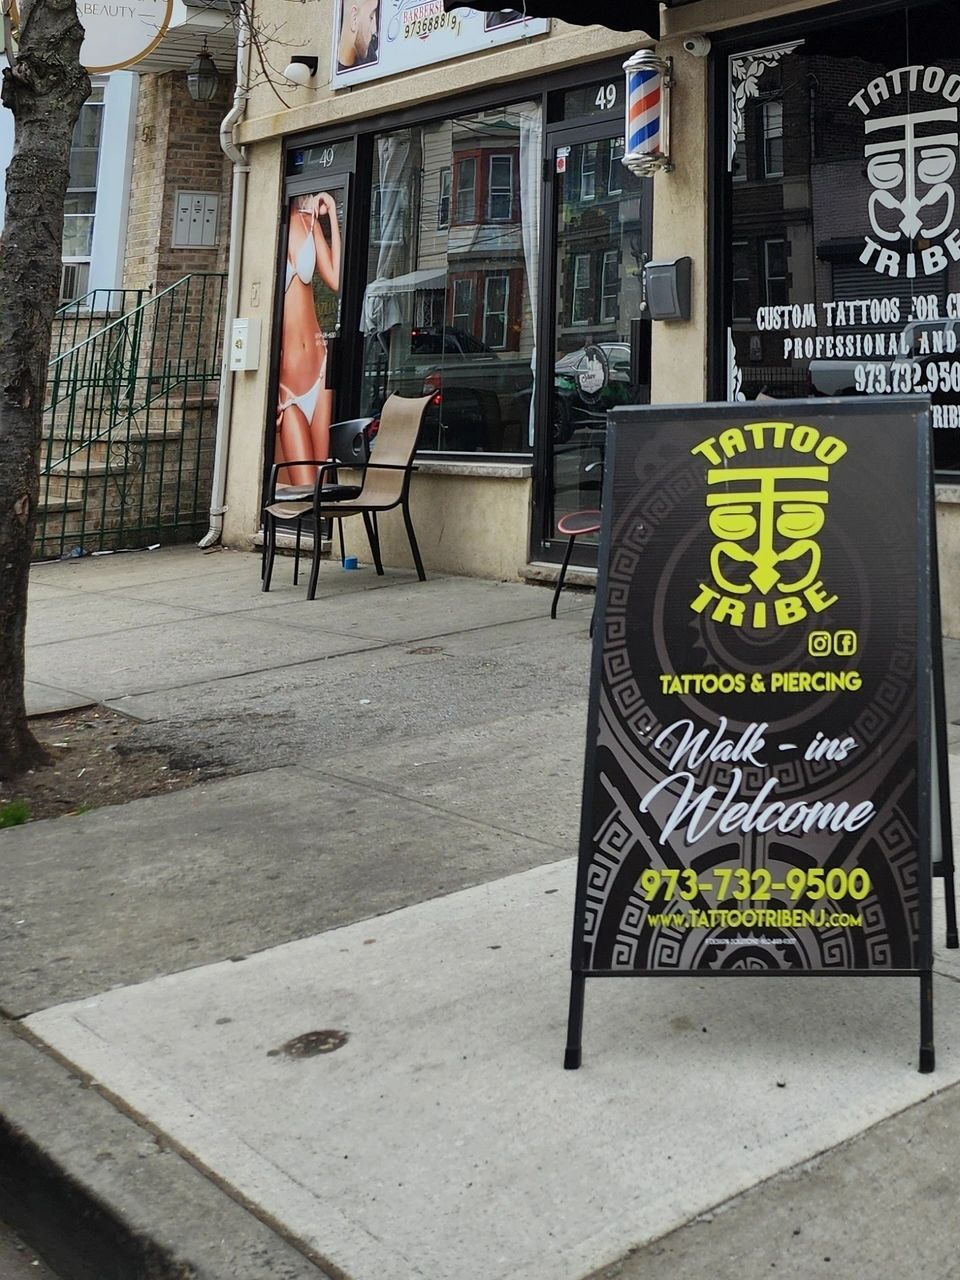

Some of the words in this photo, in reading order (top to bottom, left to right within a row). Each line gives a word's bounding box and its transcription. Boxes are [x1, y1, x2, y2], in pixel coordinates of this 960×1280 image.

[594, 84, 617, 110] 49
[320, 147, 334, 168] 49
[756, 303, 817, 331] CUSTOM
[823, 297, 901, 327] TATTOOS
[783, 332, 910, 360] PROFESSIONAL
[919, 330, 957, 355] AND
[690, 422, 848, 466] TATTOO
[690, 580, 839, 629] TRIBE
[659, 673, 746, 695] TATTOOS
[750, 673, 766, 693] &
[771, 671, 862, 692] PIERCING
[654, 716, 769, 771] Walk
[639, 767, 877, 846] Welcome
[640, 867, 872, 902] 973-732-9500
